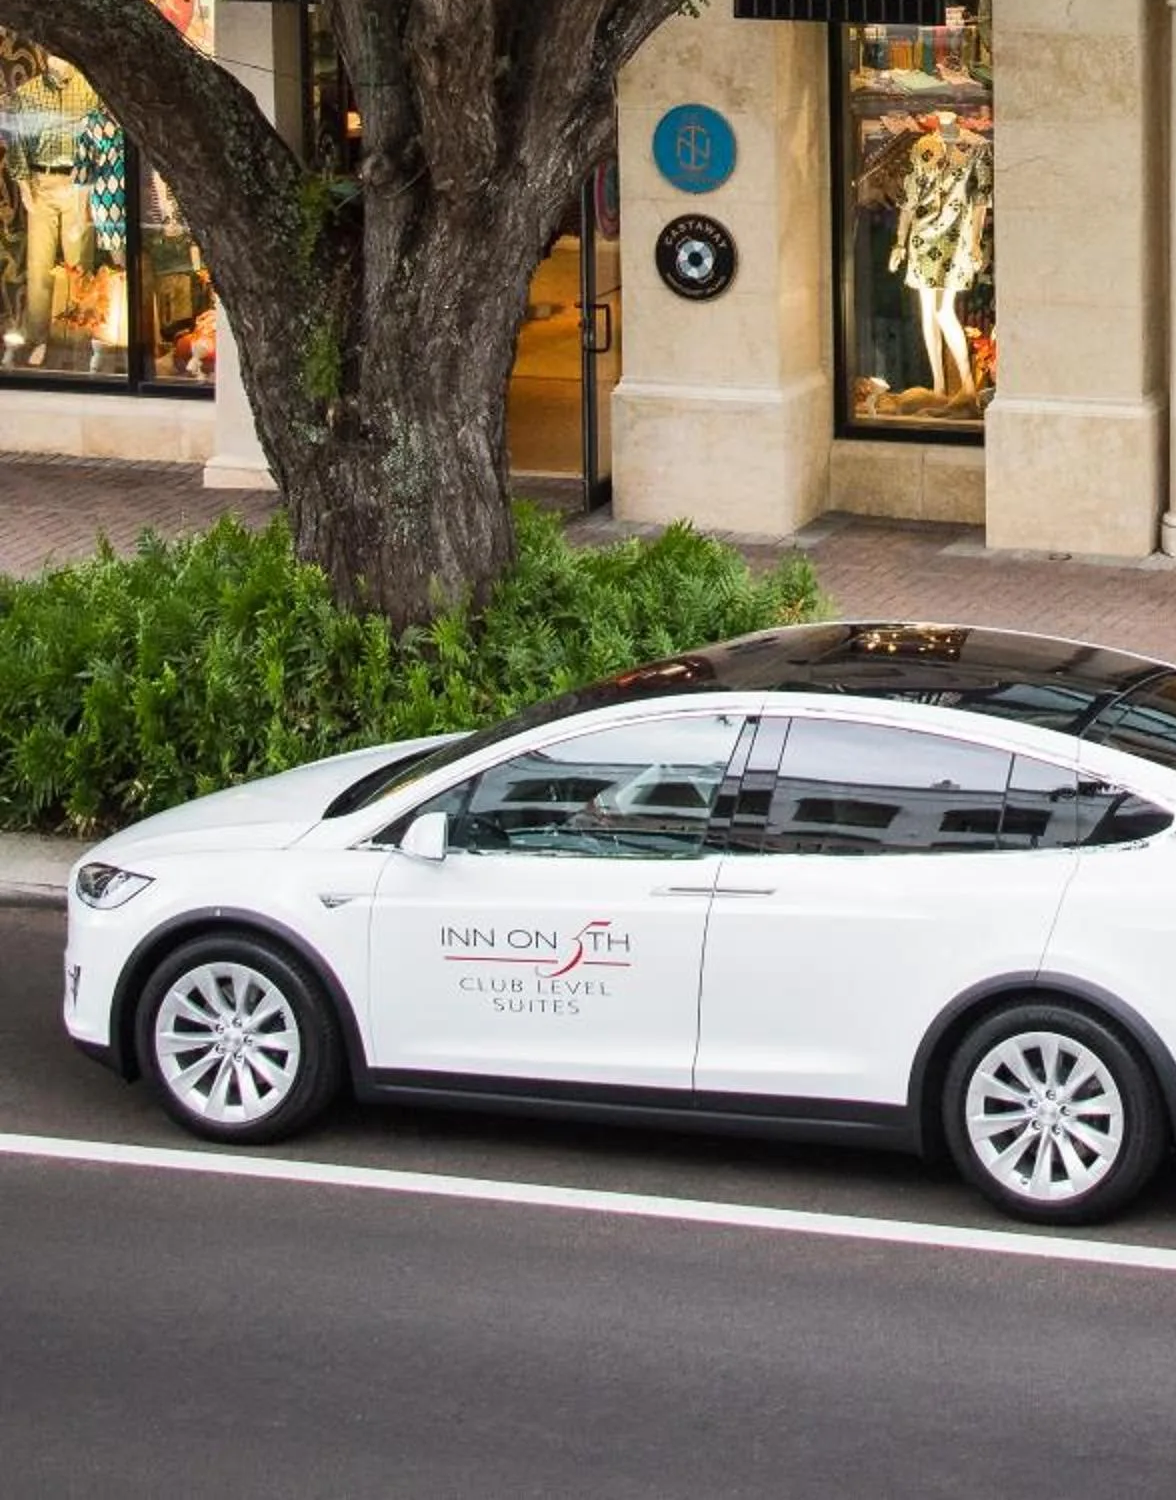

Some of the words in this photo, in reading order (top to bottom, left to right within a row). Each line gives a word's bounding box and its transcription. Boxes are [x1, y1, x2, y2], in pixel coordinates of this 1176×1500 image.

[664, 220, 729, 249] CASTAWAY
[441, 925, 495, 948] INN
[507, 929, 557, 950] ON
[459, 976, 524, 994] CLUB
[536, 979, 612, 997] LEVEL
[493, 997, 581, 1016] SUITES
